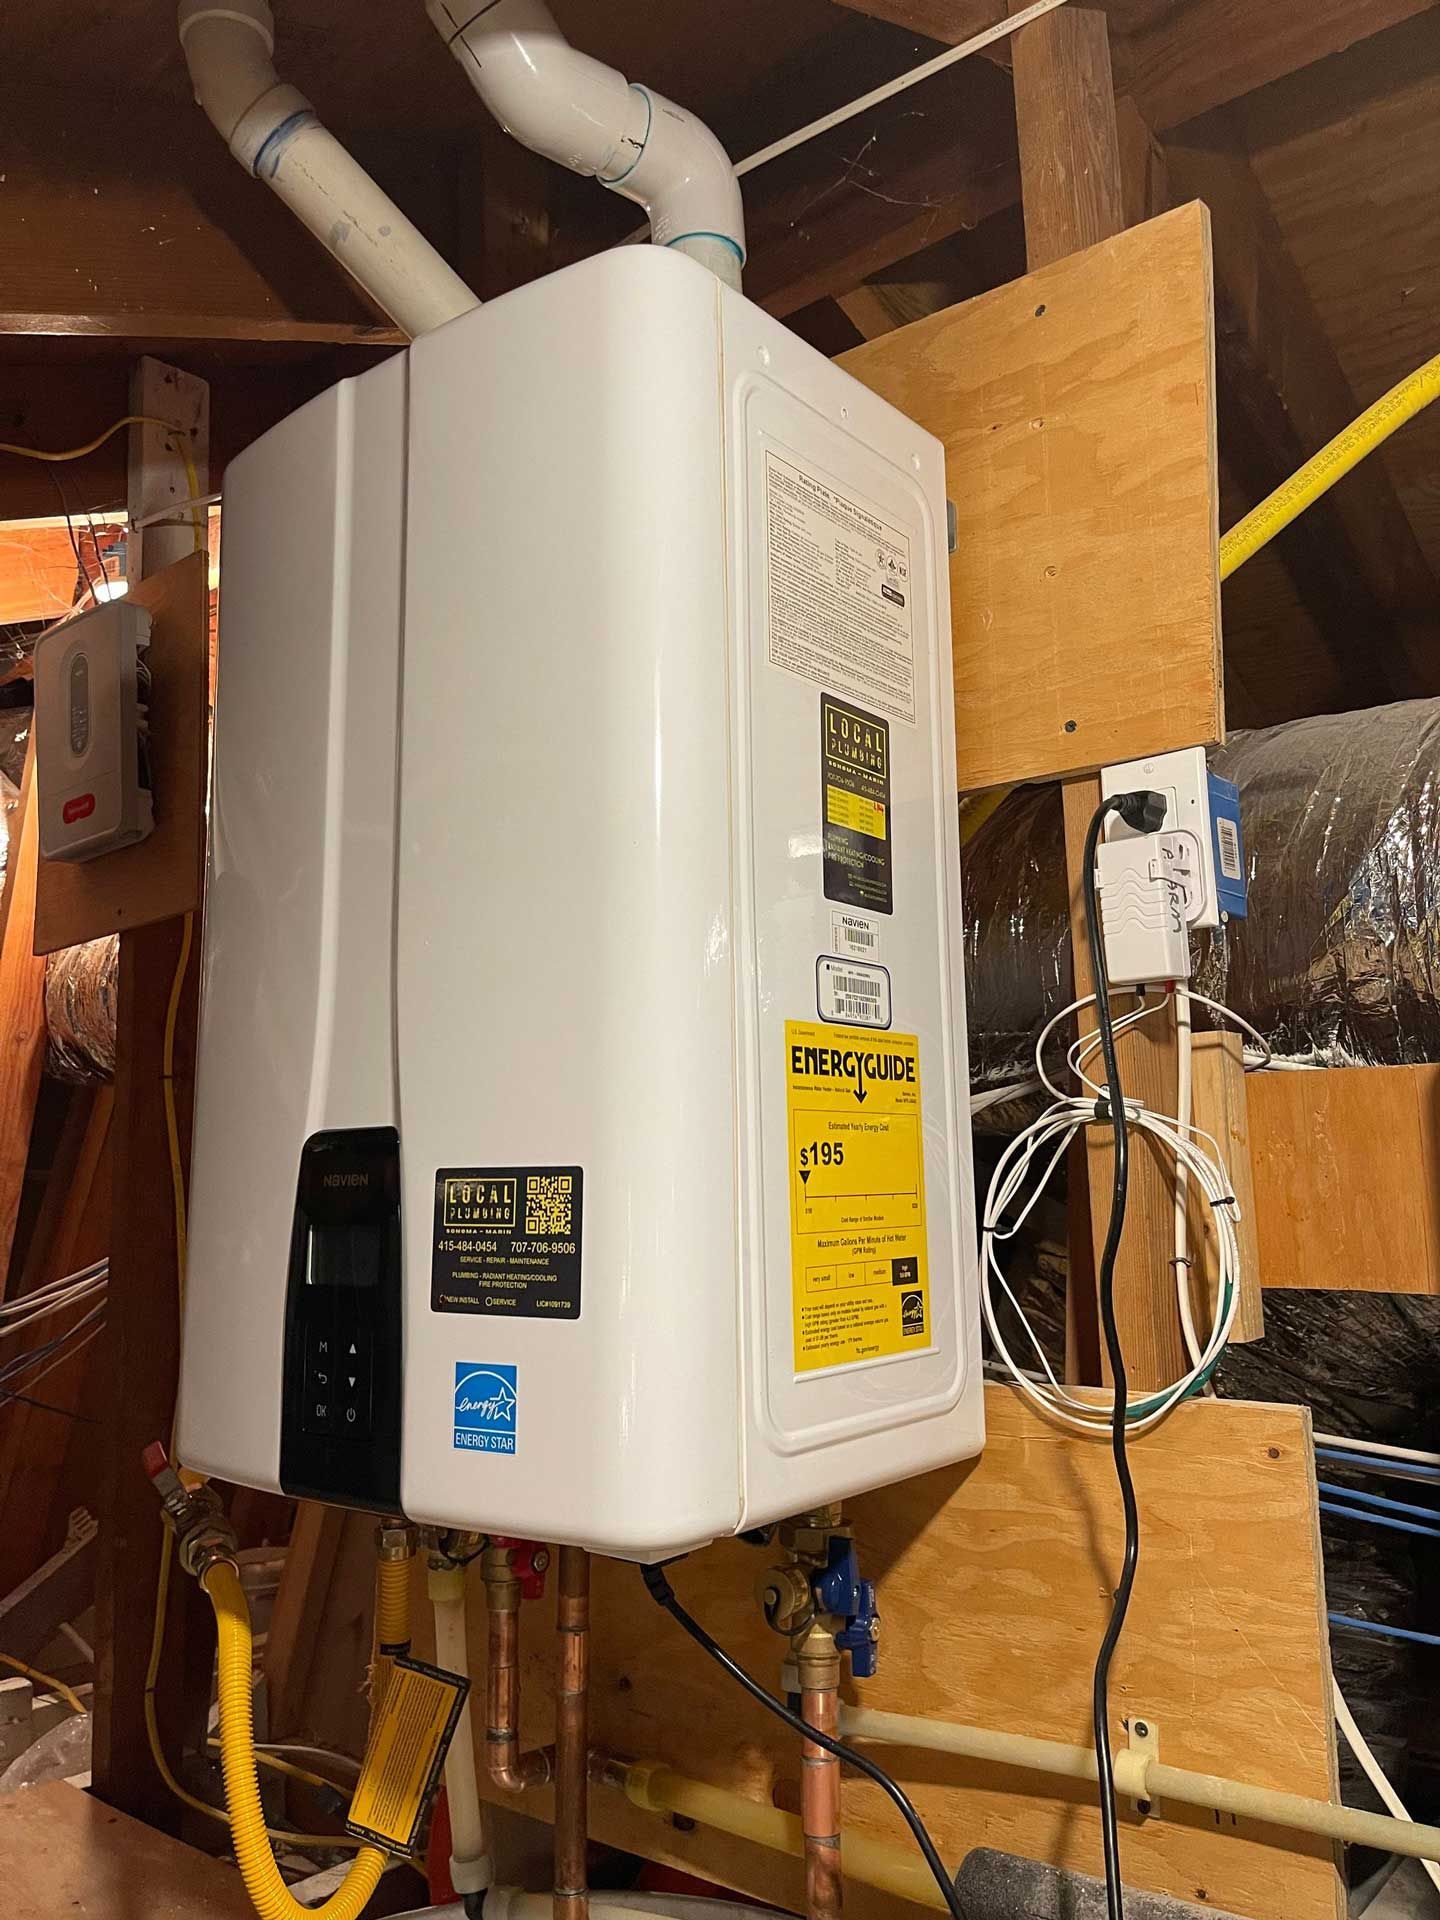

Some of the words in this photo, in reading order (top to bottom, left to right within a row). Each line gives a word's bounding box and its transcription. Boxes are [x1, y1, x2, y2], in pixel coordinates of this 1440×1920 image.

[830, 712, 882, 753] LOCAL
[831, 738, 882, 769] PLUMBING
[792, 1045, 916, 1083] ENERGYGUIDE
[864, 1122, 879, 1133] Energy
[800, 1141, 844, 1167] $195
[449, 1184, 512, 1204] LOCAL
[450, 1207, 511, 1220] PLUMBING
[438, 1240, 497, 1252] 415-484-0454
[511, 1241, 576, 1254] 707-706-9506
[817, 1239, 840, 1249] Maximum
[840, 1238, 858, 1247] Gallons
[867, 1236, 881, 1245] Minute
[460, 1256, 482, 1264] SERVICE
[509, 1257, 550, 1266] MAINTENANCE
[452, 1271, 479, 1279] PLUMBING
[482, 1272, 506, 1280] RADIANT
[491, 1281, 527, 1289] PROTECTION
[492, 1299, 517, 1307] SERVICE
[318, 1341, 328, 1353] M
[316, 1403, 327, 1417] OK
[455, 1432, 490, 1448] ENERGY
[490, 1436, 514, 1450] STAR
